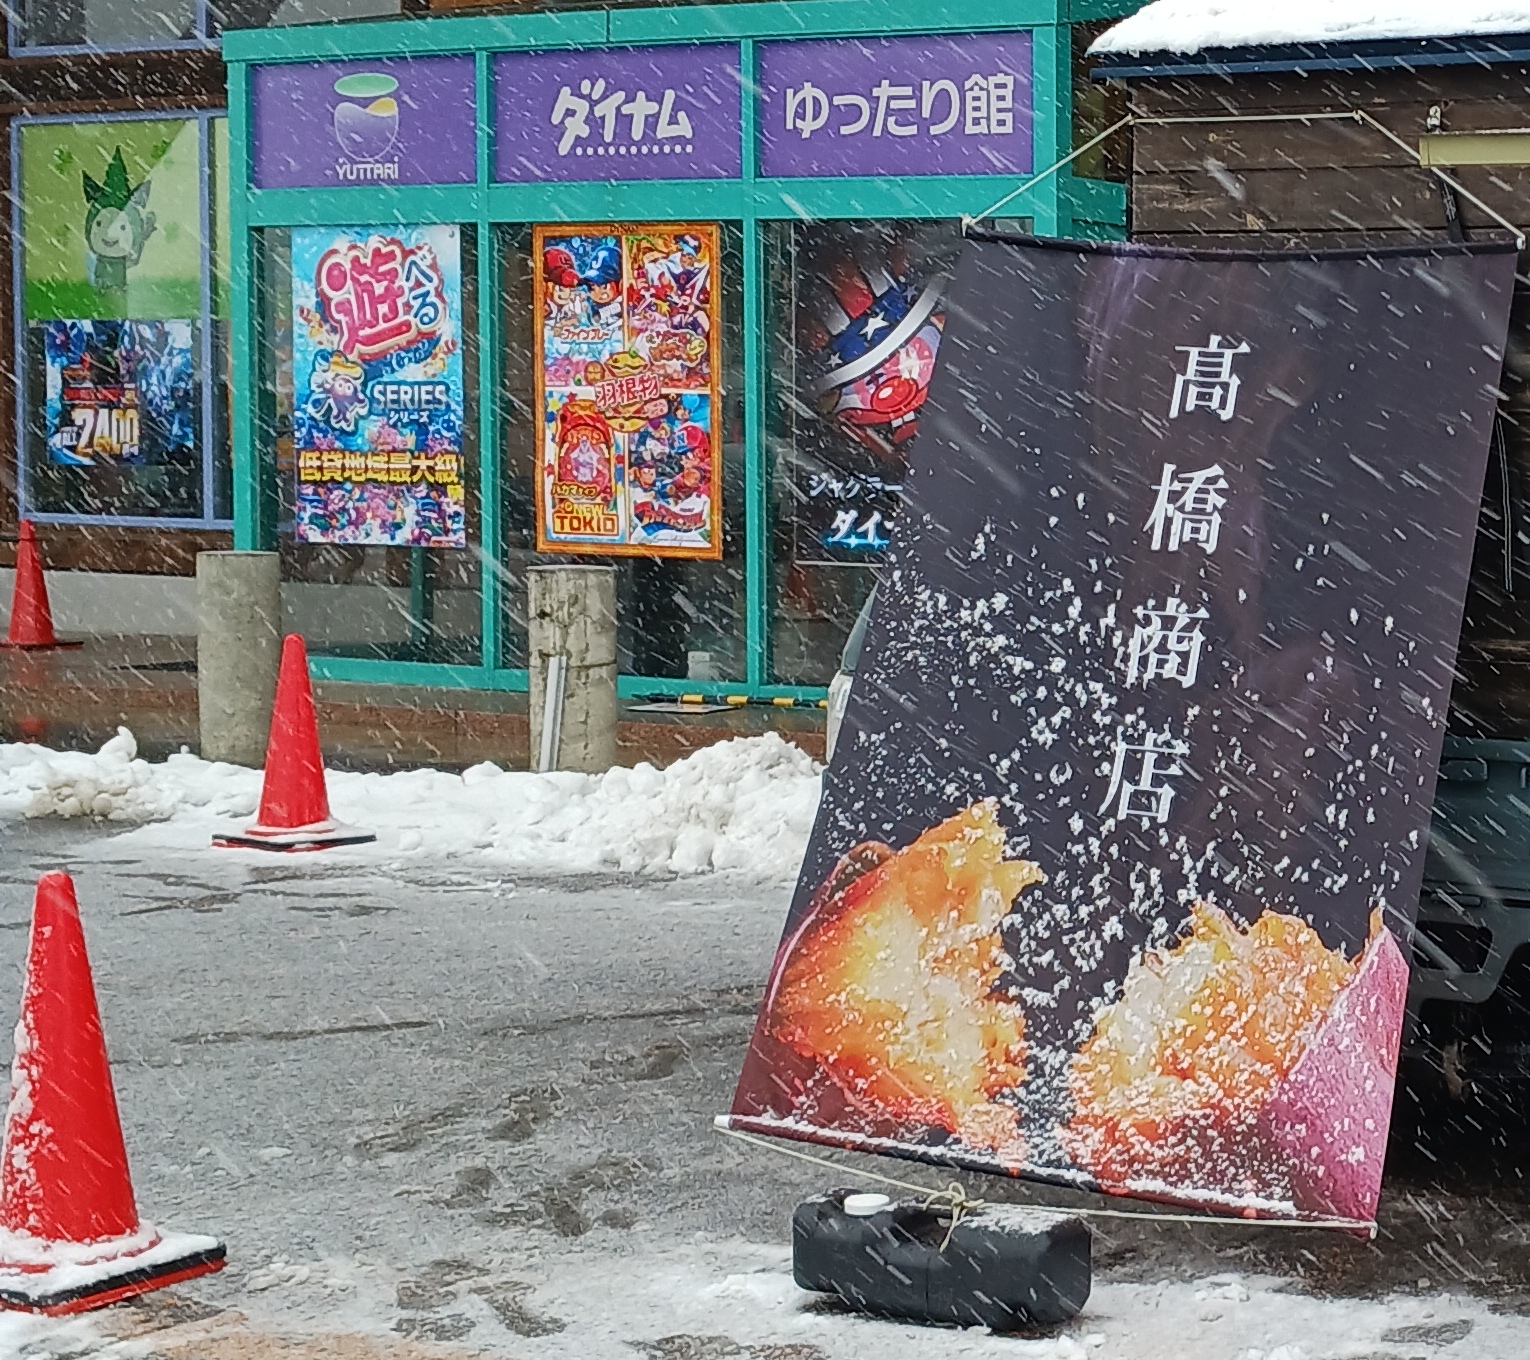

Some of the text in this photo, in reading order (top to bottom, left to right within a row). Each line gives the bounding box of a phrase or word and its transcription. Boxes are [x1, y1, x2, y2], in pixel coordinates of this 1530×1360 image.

[551, 77, 693, 156] ダイナム
[784, 72, 1015, 139] ゆったり館
[324, 244, 440, 356] 遊べる
[373, 384, 447, 410] SERIES
[388, 410, 431, 426] シリーズ
[555, 515, 616, 533] TOKIO
